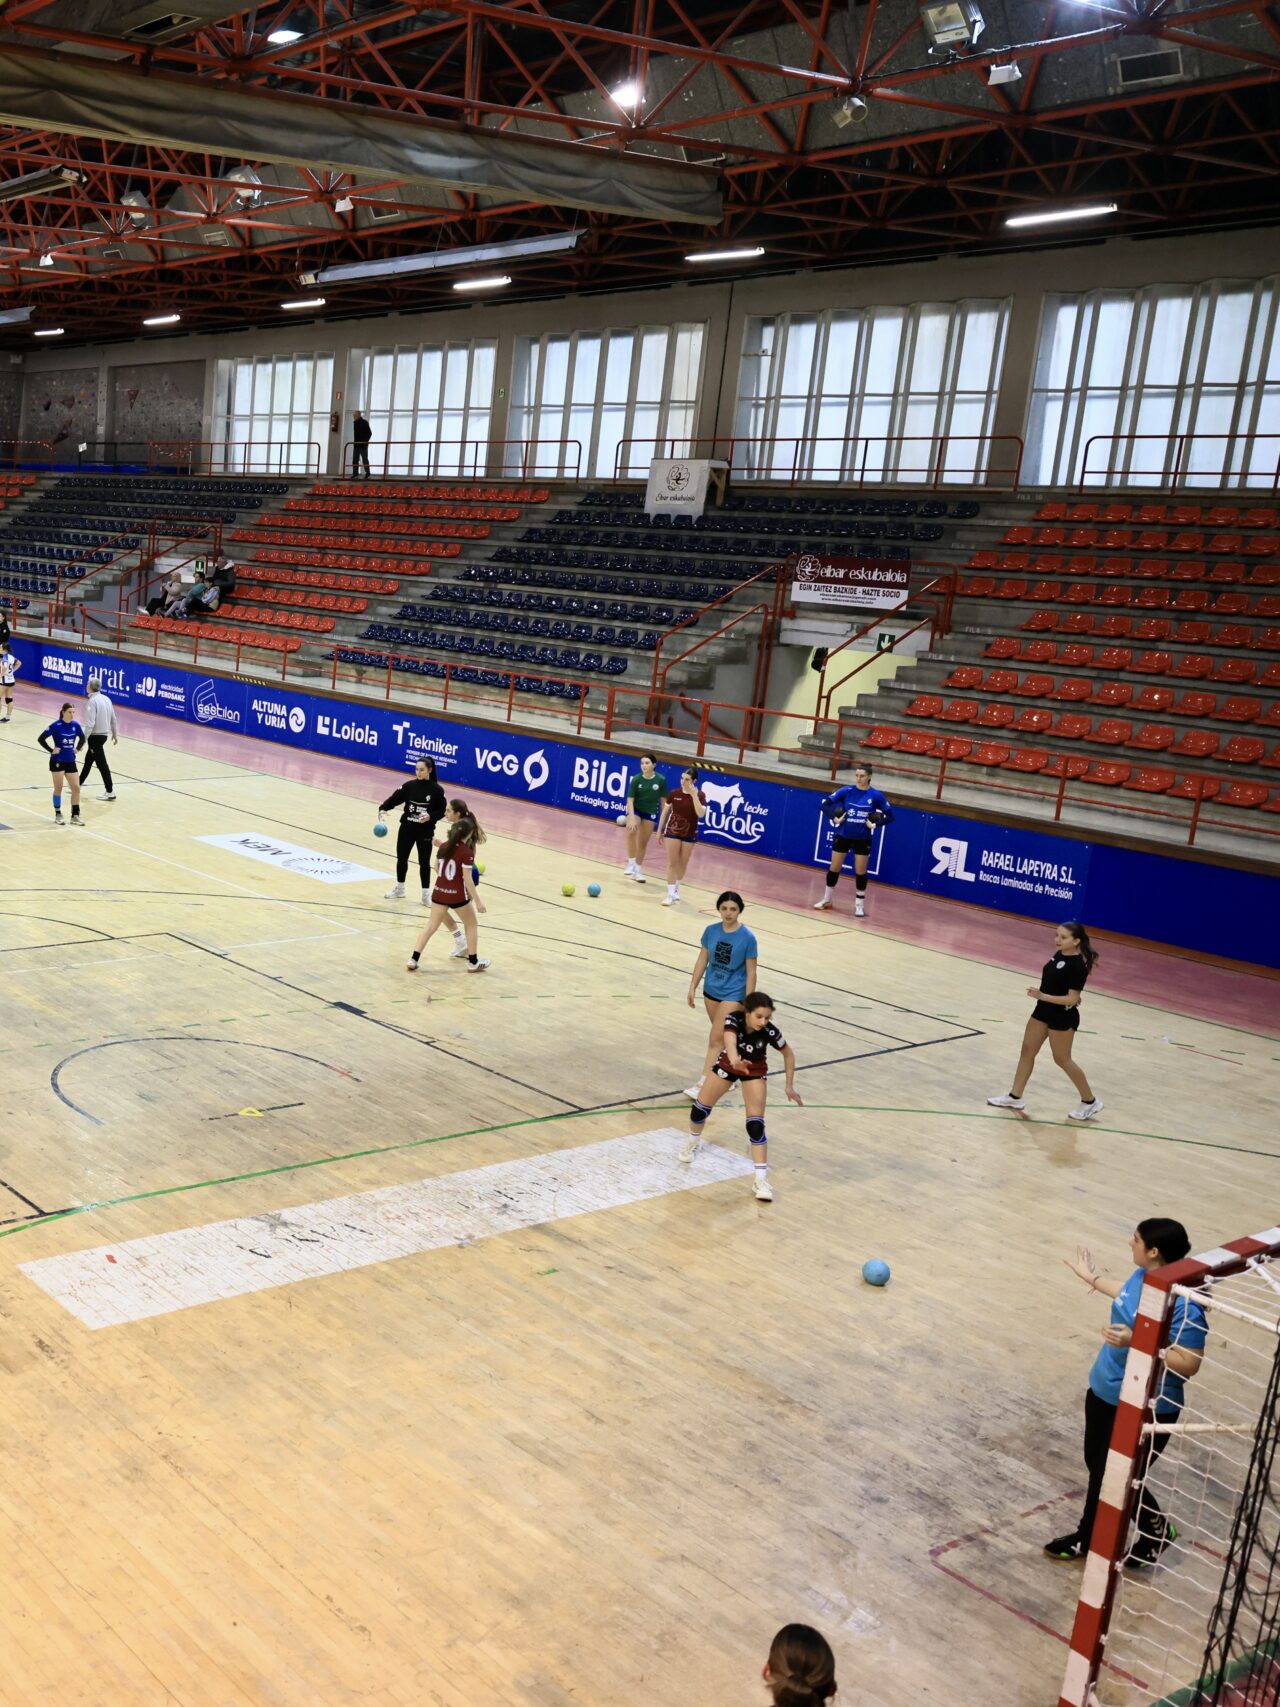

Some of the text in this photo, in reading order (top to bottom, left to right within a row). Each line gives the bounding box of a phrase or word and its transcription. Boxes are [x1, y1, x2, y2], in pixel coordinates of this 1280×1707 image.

[849, 567, 907, 583] eskubaloia
[813, 585, 833, 593] ZAITEZ
[158, 690, 186, 702] PEROSANZ
[252, 699, 287, 717] ALTUNA
[257, 712, 287, 729] Y URIA
[332, 718, 378, 747] Loiola
[408, 732, 458, 756] Tekniker
[475, 747, 519, 776] VCG
[573, 757, 633, 798] Bild
[570, 792, 629, 815] Packaging Solu
[744, 801, 769, 816] leche
[697, 805, 765, 837] turale
[438, 858, 457, 881] 10
[981, 850, 1076, 885] RAFAEL LAPEYRA S.L.
[979, 870, 1073, 900] Roscas Laminadas de Precisión
